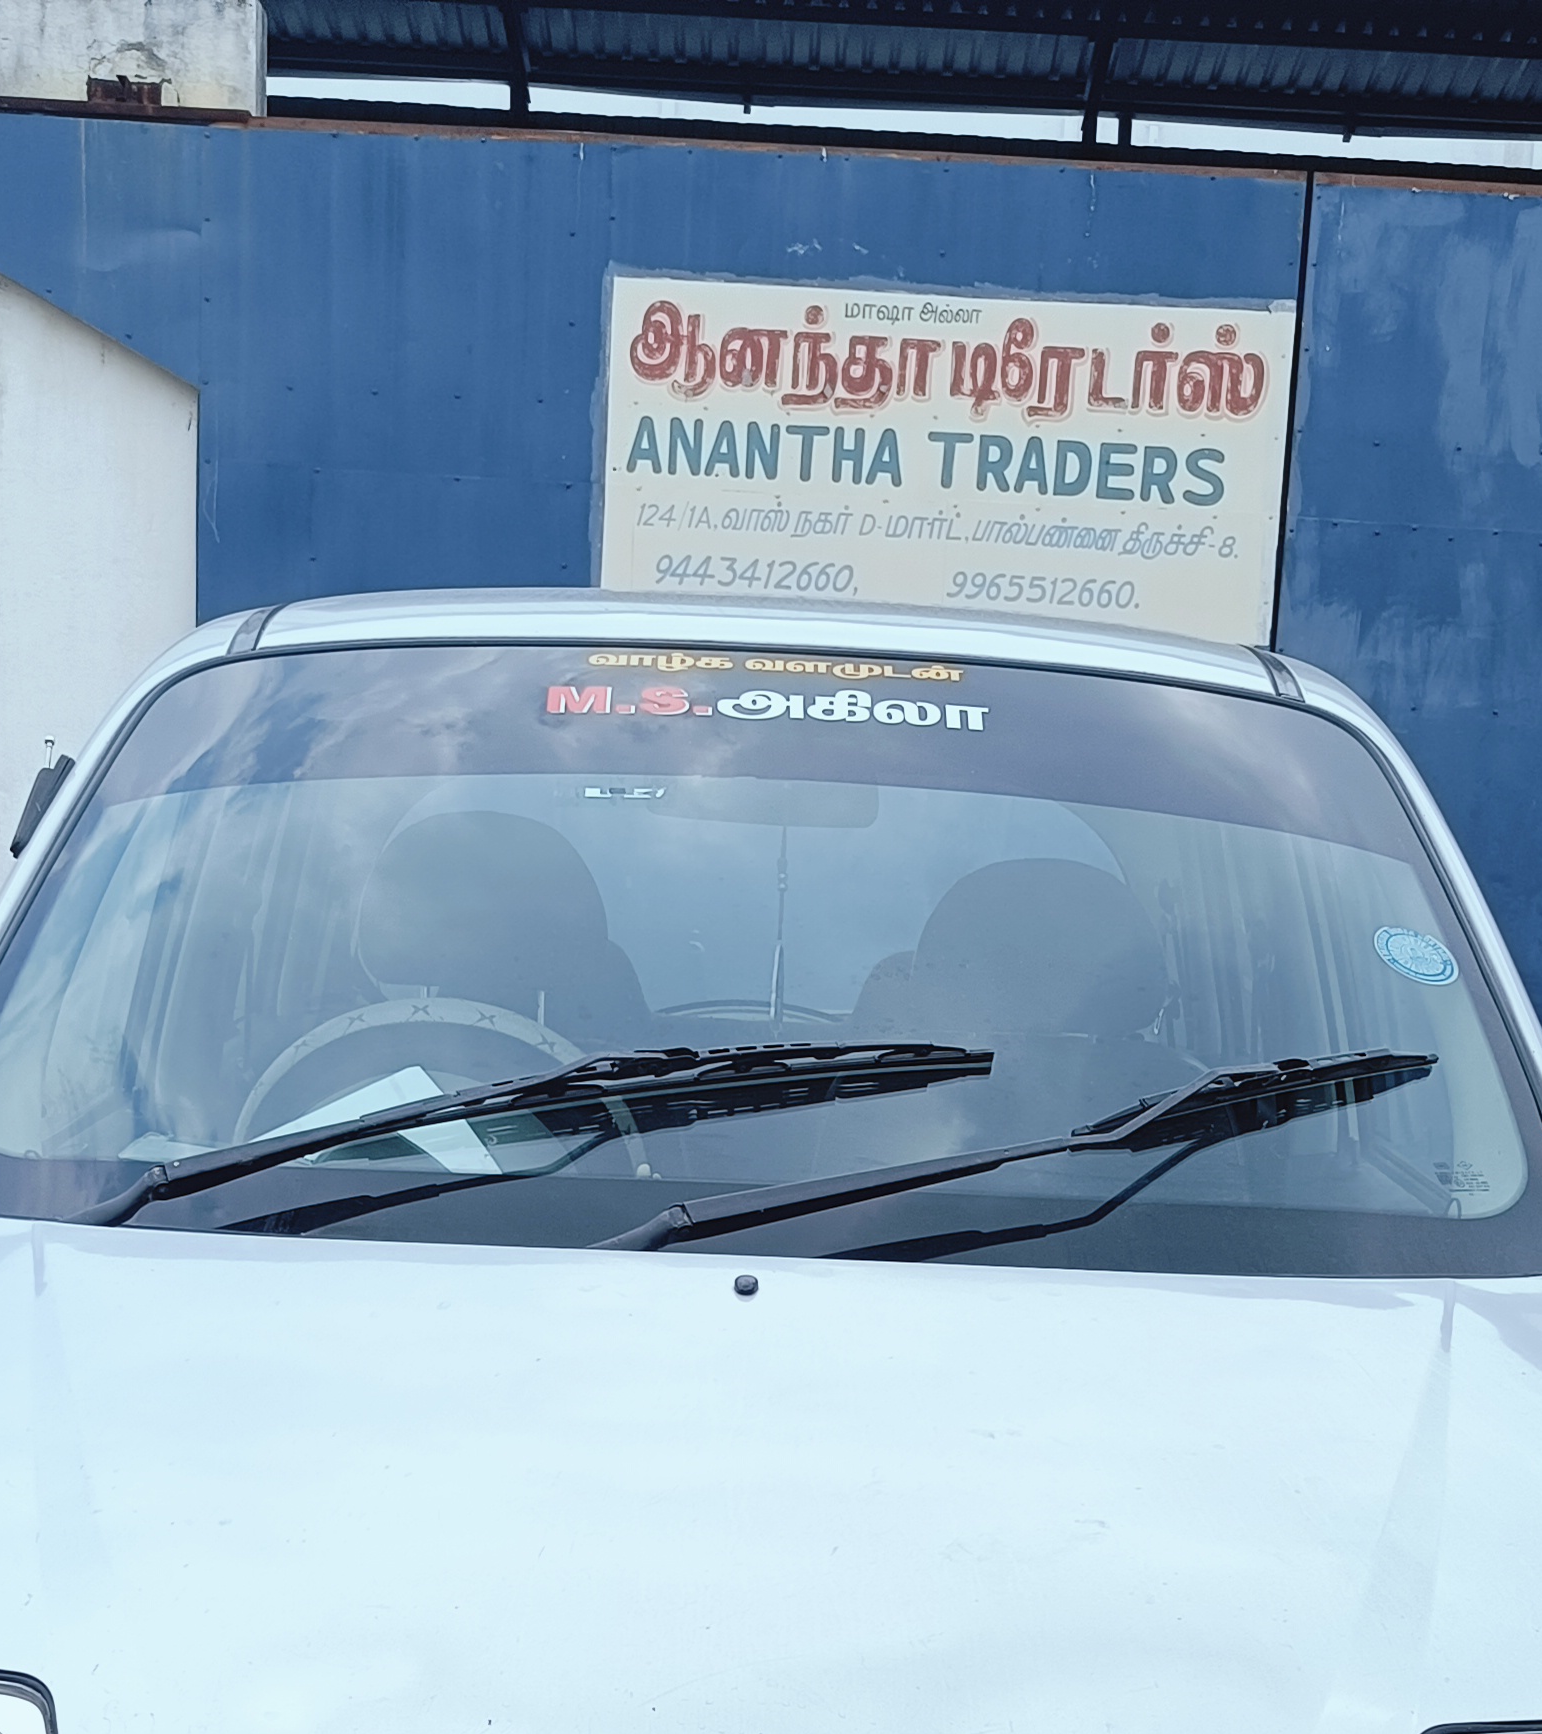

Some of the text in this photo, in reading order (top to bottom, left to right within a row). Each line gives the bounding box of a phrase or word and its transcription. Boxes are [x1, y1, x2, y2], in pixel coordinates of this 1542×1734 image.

[845, 301, 982, 326] மாஷா அல்லா
[629, 299, 1265, 418] ஆனந்தா டிரேடர்ஸ்
[626, 416, 1226, 506] ANANTHA TRADERS
[655, 554, 1140, 610] 9443412660, 9965512660.
[588, 653, 964, 682] வாழ்க வளமுடன்
